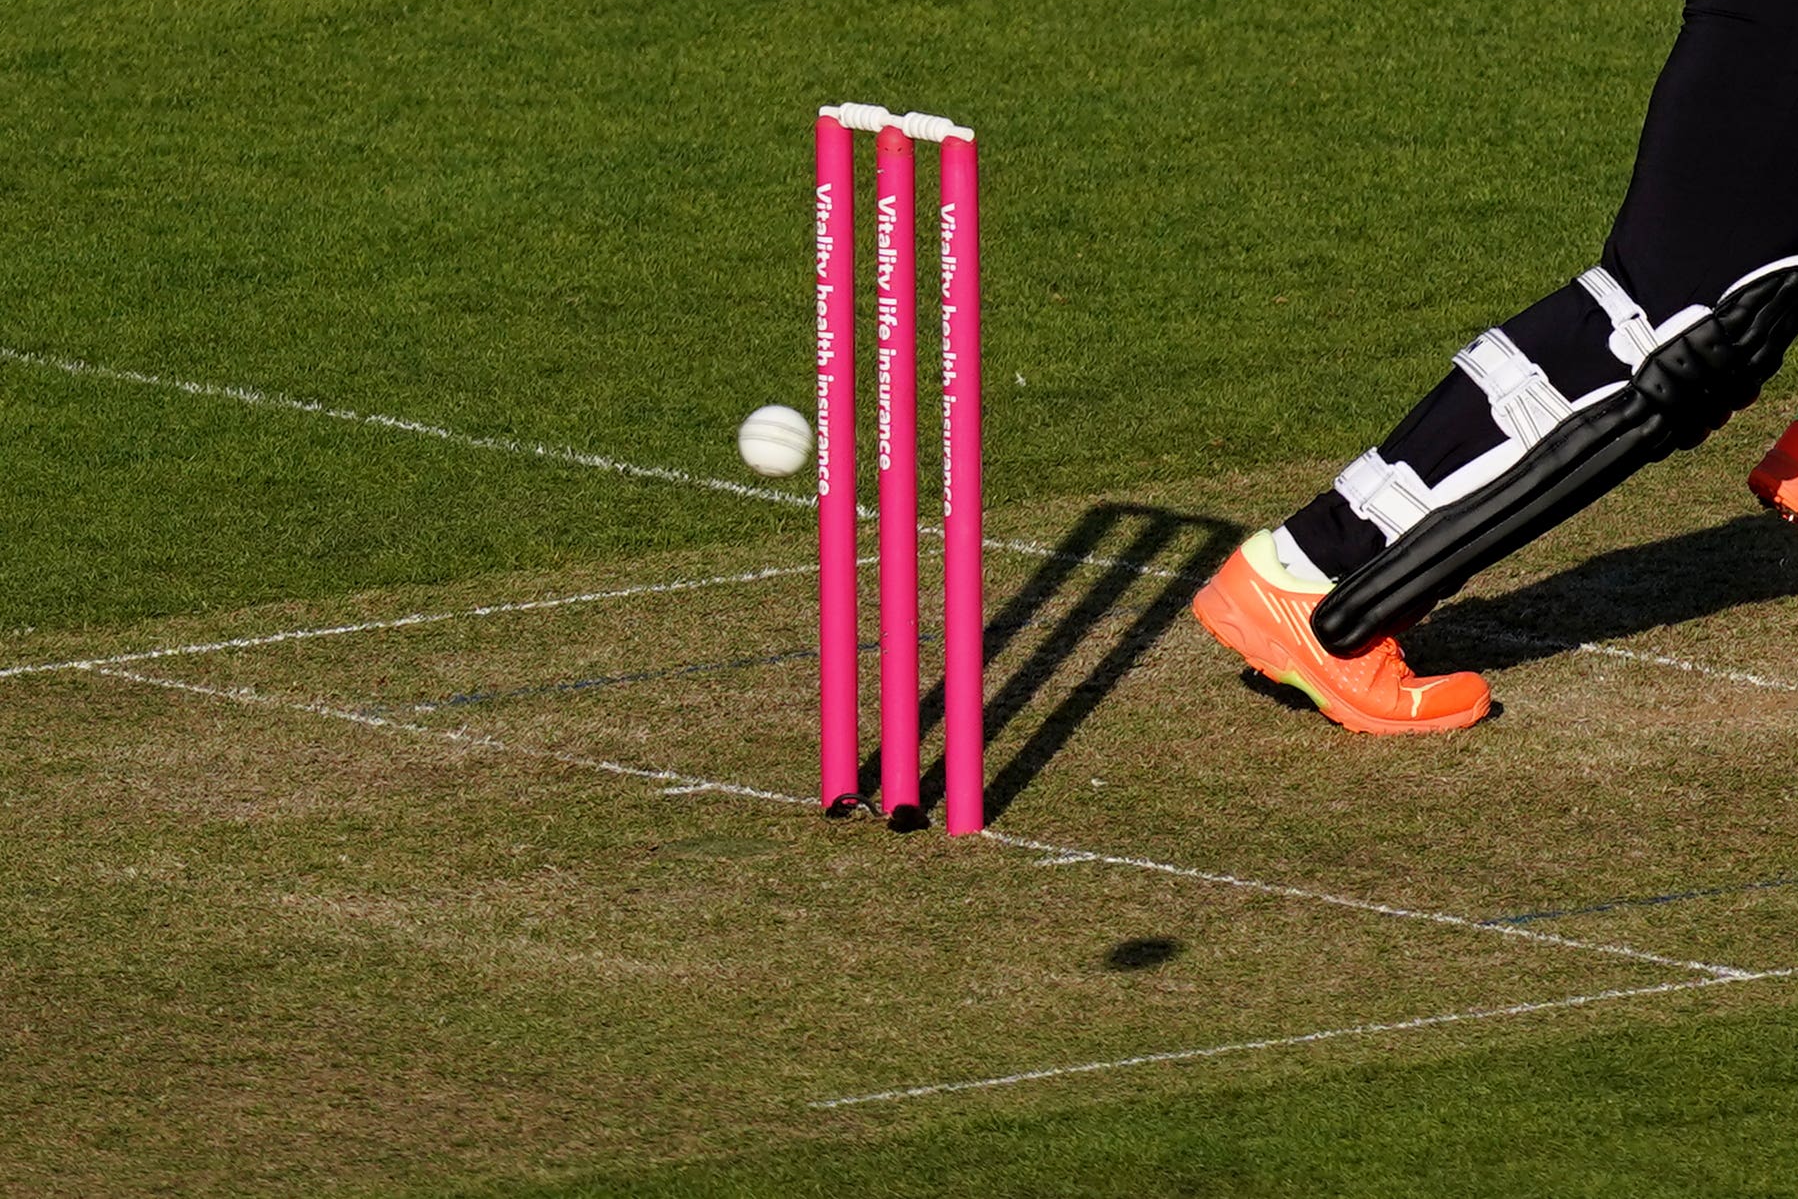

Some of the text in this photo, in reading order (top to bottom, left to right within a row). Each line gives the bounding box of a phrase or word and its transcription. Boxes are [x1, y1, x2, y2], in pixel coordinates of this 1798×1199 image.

[816, 183, 835, 496] Vitality health insurance
[877, 195, 898, 471] Vitality life insurance
